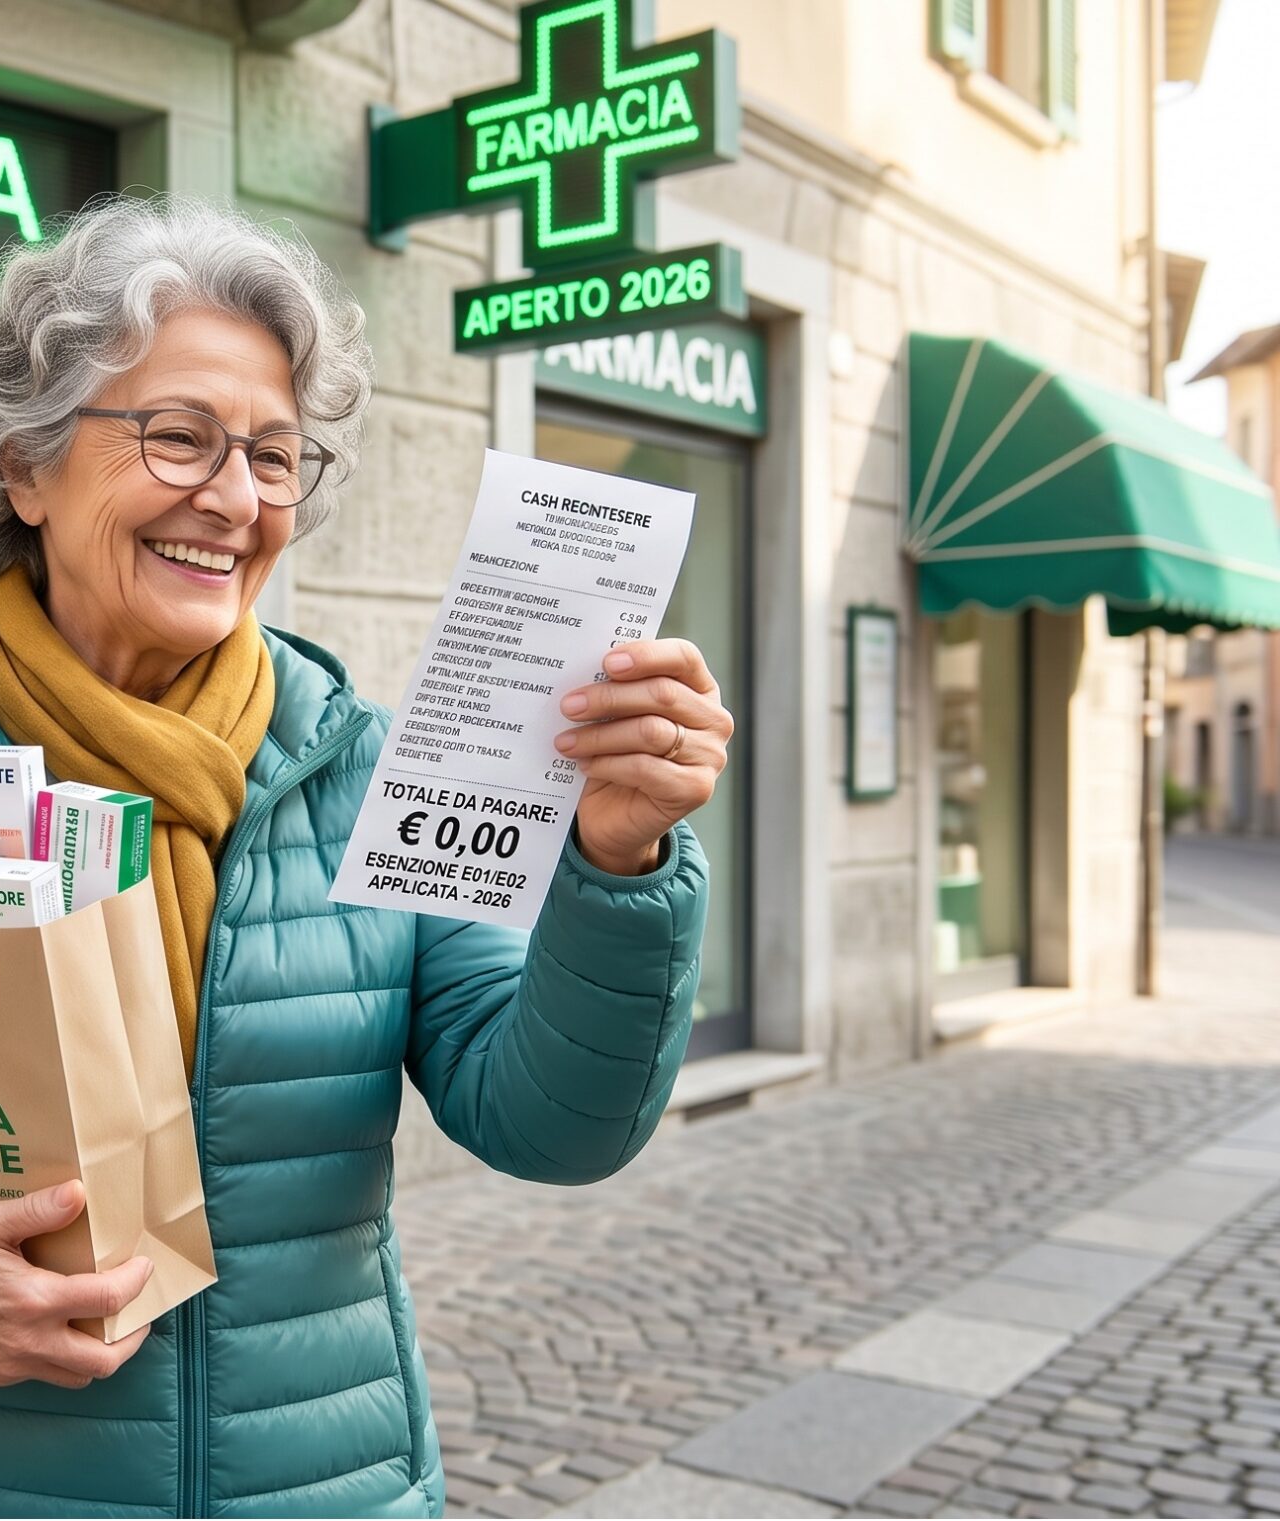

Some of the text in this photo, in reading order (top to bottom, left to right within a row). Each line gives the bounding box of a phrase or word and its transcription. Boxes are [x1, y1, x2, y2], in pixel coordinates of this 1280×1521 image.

[476, 80, 693, 171] FARMACIA
[462, 259, 711, 338] APERTO 2026
[521, 490, 559, 509] CASH
[383, 781, 559, 824] TOTALE DA PAGARE:
[397, 811, 520, 859] € 0,00
[365, 852, 527, 890] ESENZIONE E01/E02
[368, 875, 459, 900] APPLICATA
[472, 889, 512, 909] 2026
